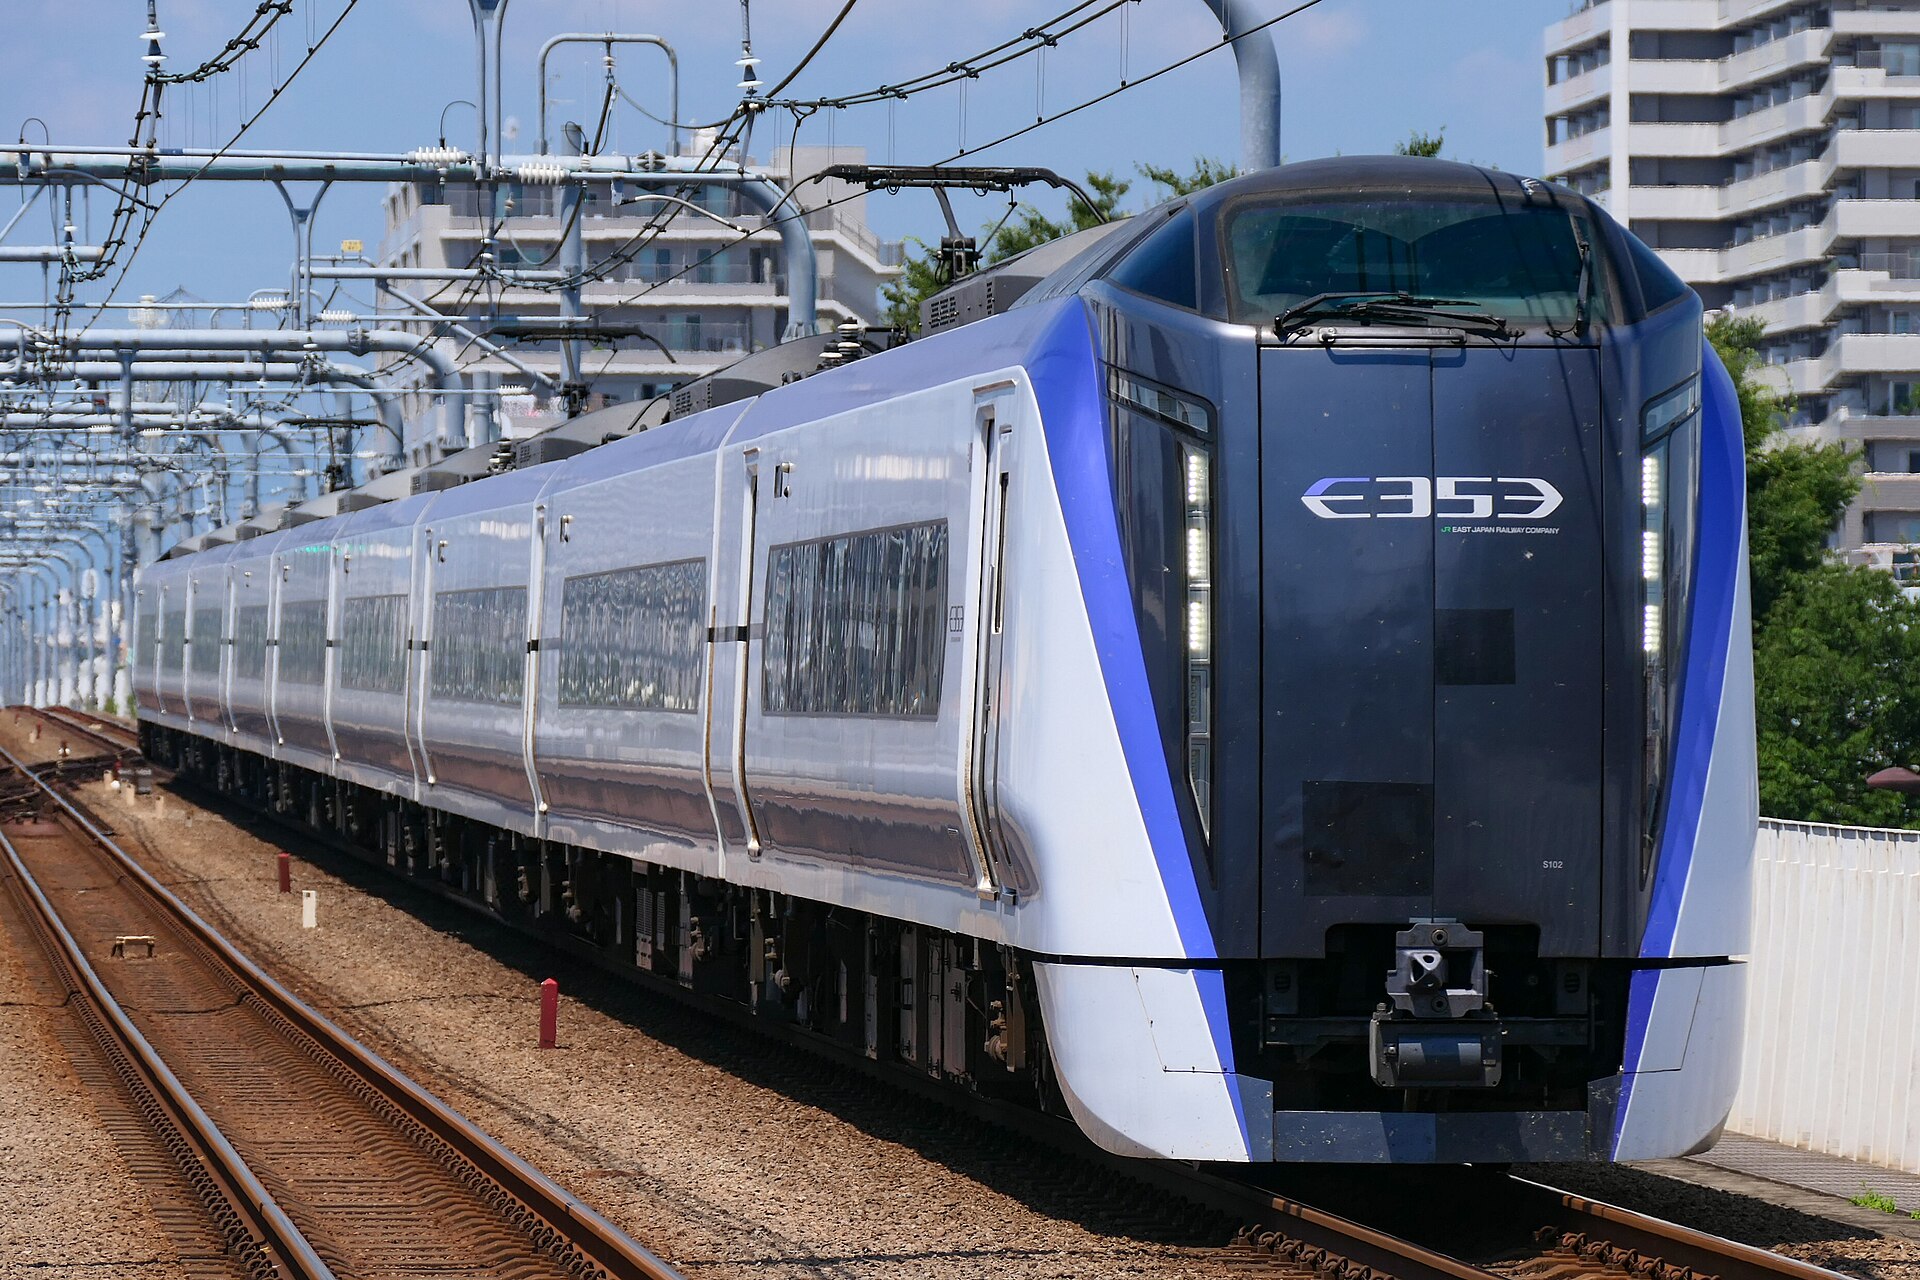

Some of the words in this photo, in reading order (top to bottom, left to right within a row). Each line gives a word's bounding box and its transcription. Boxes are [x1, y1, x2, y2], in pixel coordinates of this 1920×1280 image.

[1300, 477, 1563, 519] E353
[1495, 526, 1525, 534] RAILWAY
[1542, 860, 1563, 869] S102
